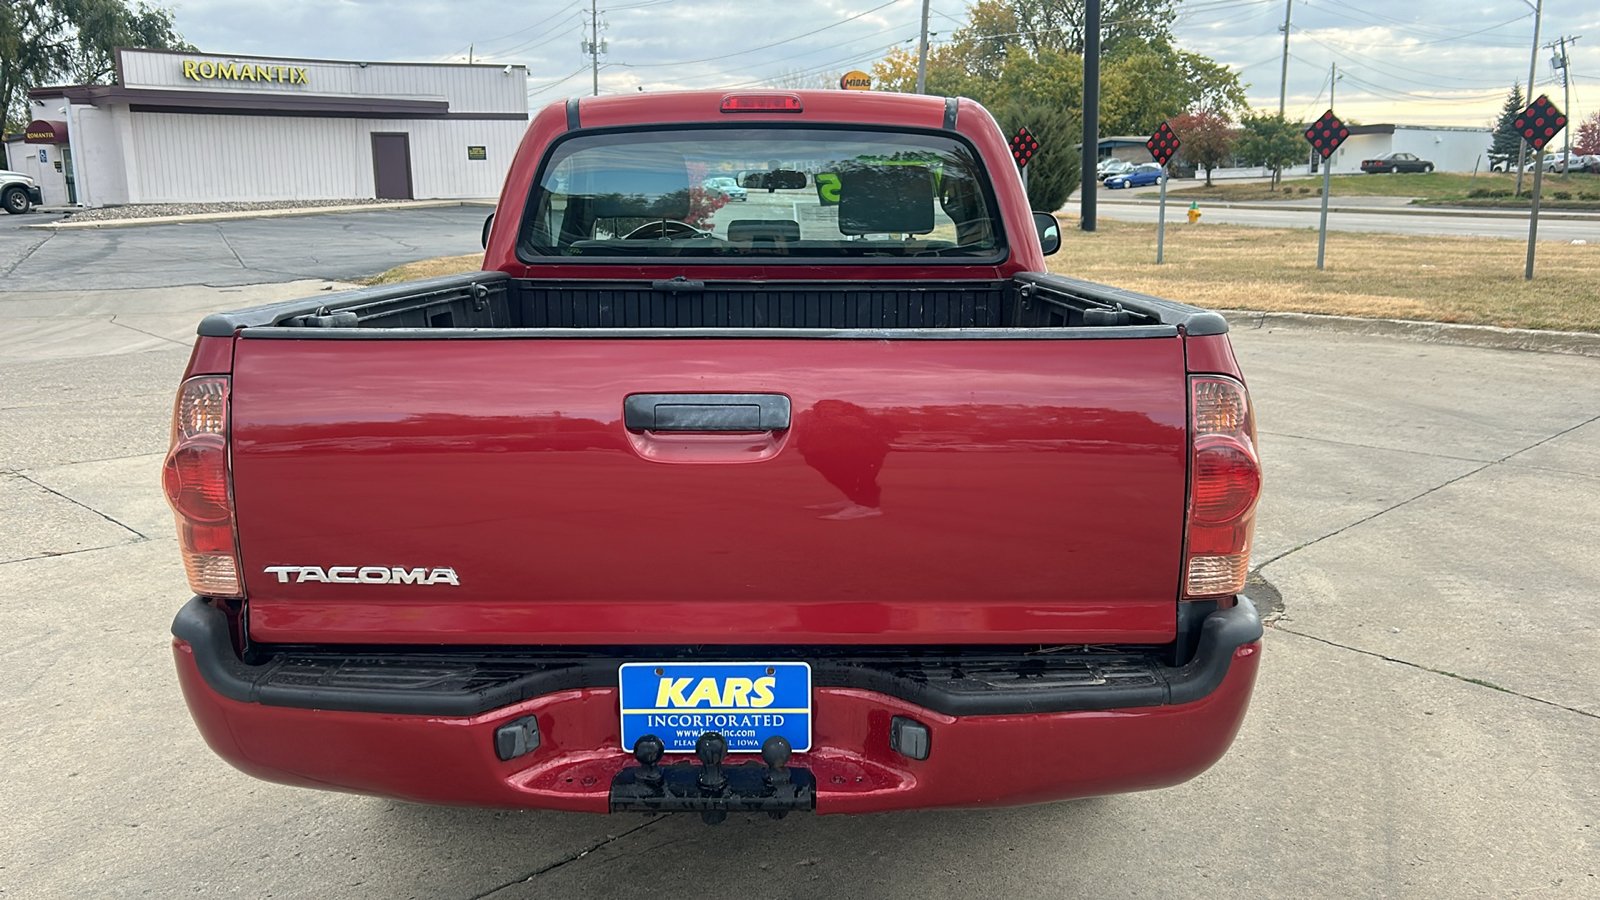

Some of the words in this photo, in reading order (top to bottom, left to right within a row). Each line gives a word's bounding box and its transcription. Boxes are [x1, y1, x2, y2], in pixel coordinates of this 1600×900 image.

[183, 60, 309, 85] ROMANTIX
[846, 78, 871, 87] MIDAS
[26, 132, 55, 140] ROMANTIX
[263, 566, 461, 586] TACOMA
[655, 676, 776, 708] KARS
[647, 714, 785, 727] INCORPORATED
[737, 739, 759, 747] IOWA
